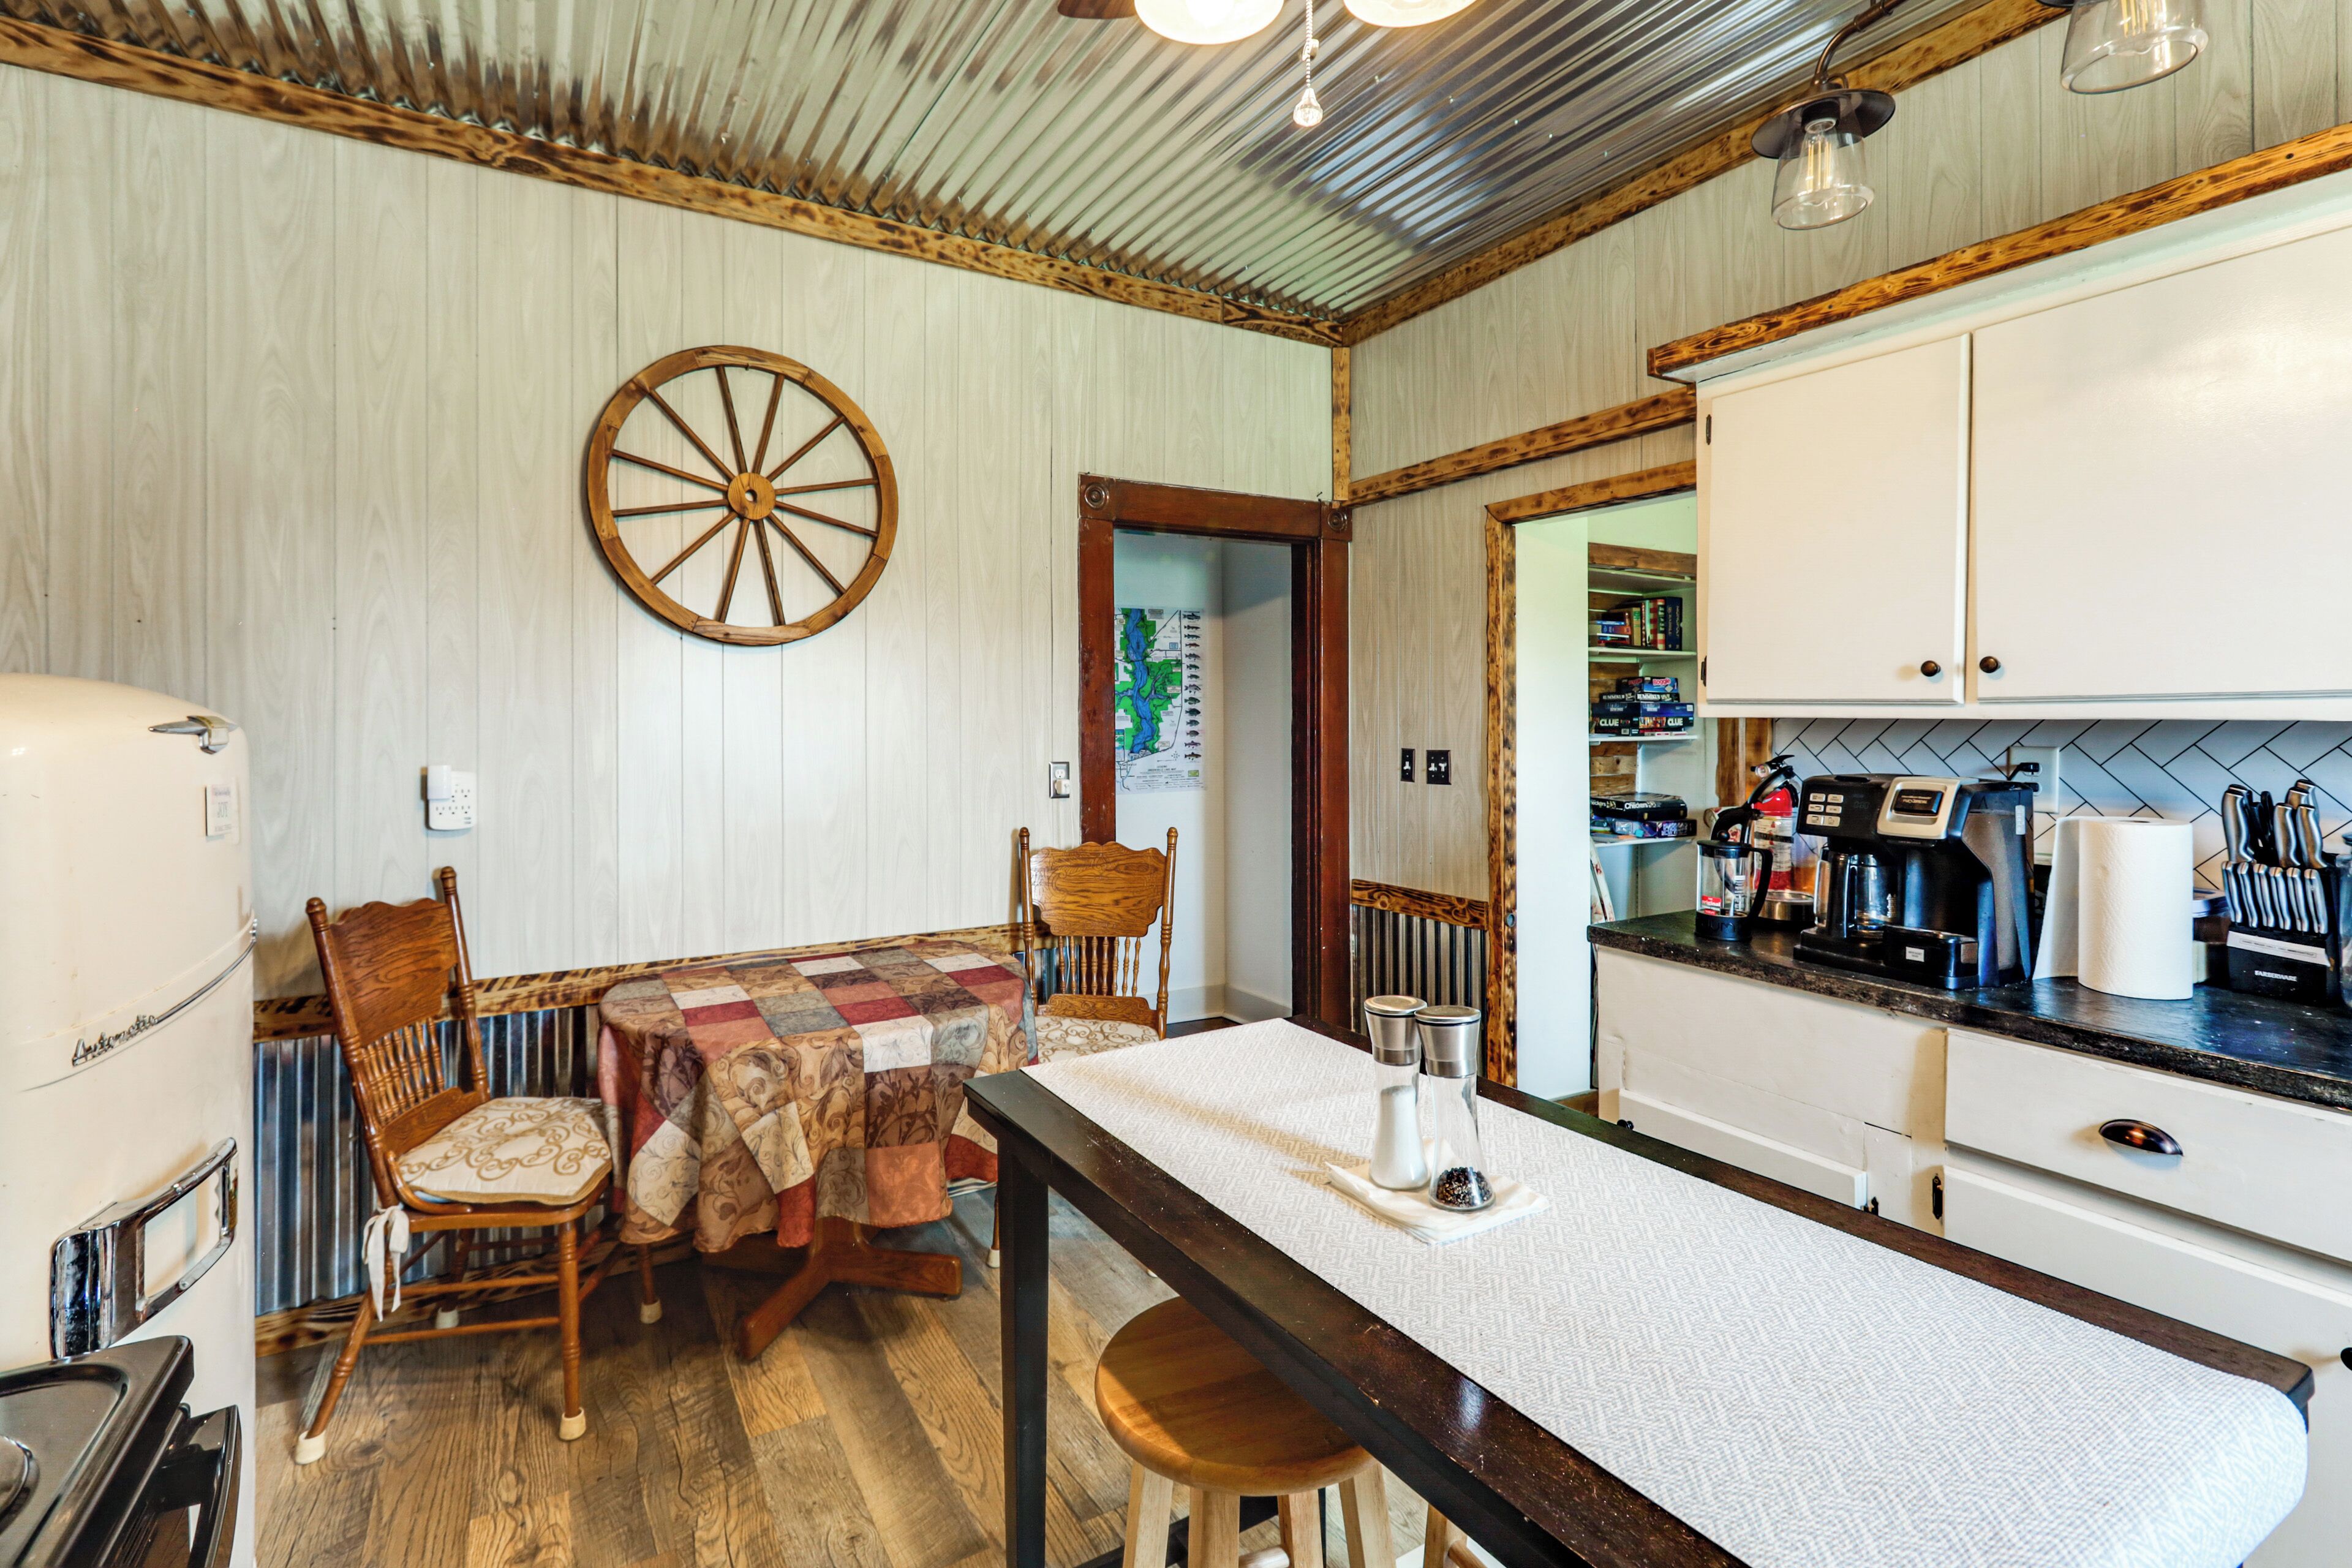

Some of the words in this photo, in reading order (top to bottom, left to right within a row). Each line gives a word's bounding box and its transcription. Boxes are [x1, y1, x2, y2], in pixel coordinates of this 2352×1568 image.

[1652, 677, 1672, 686] Boggle
[1599, 718, 1619, 726] CLUE
[1667, 717, 1683, 726] CLUE
[2254, 970, 2297, 982] FARBERWARE
